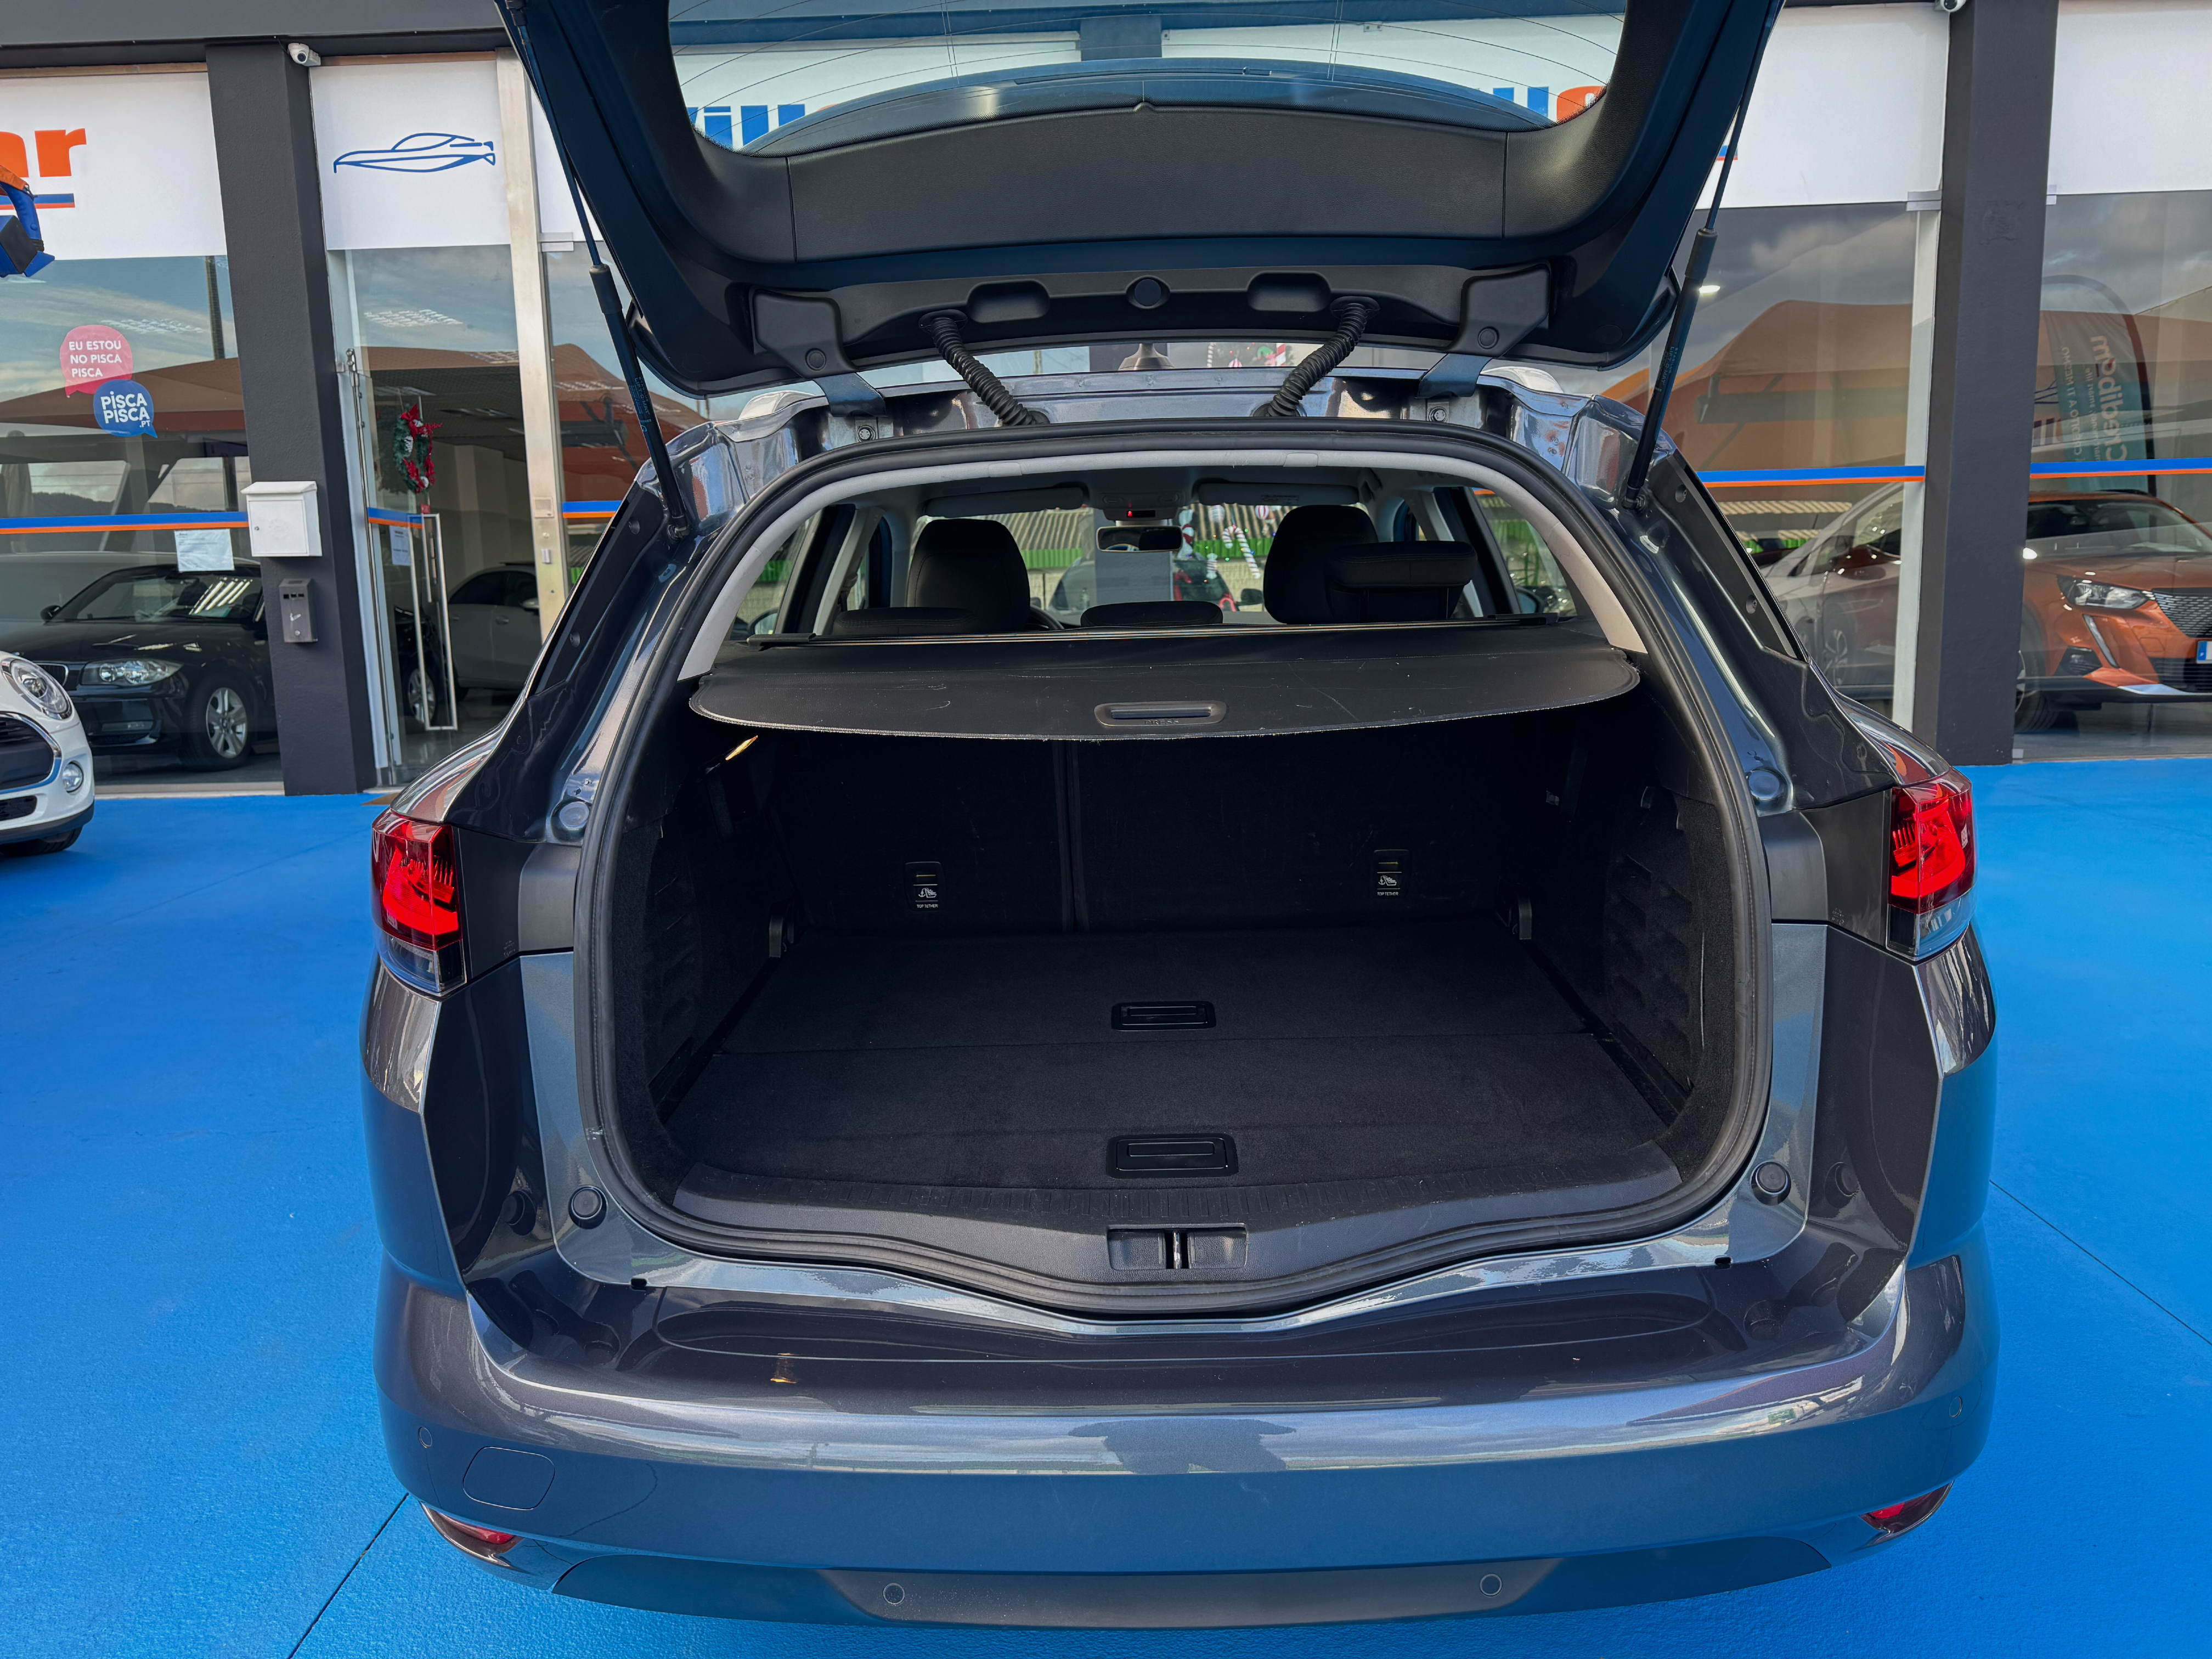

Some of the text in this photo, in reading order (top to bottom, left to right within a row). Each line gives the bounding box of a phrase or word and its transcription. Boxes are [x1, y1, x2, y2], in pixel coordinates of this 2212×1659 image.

[69, 340, 121, 351] EU ESTOU
[70, 354, 122, 364] NO PISCA
[71, 368, 103, 377] PISCA
[103, 407, 150, 424] PISCA
